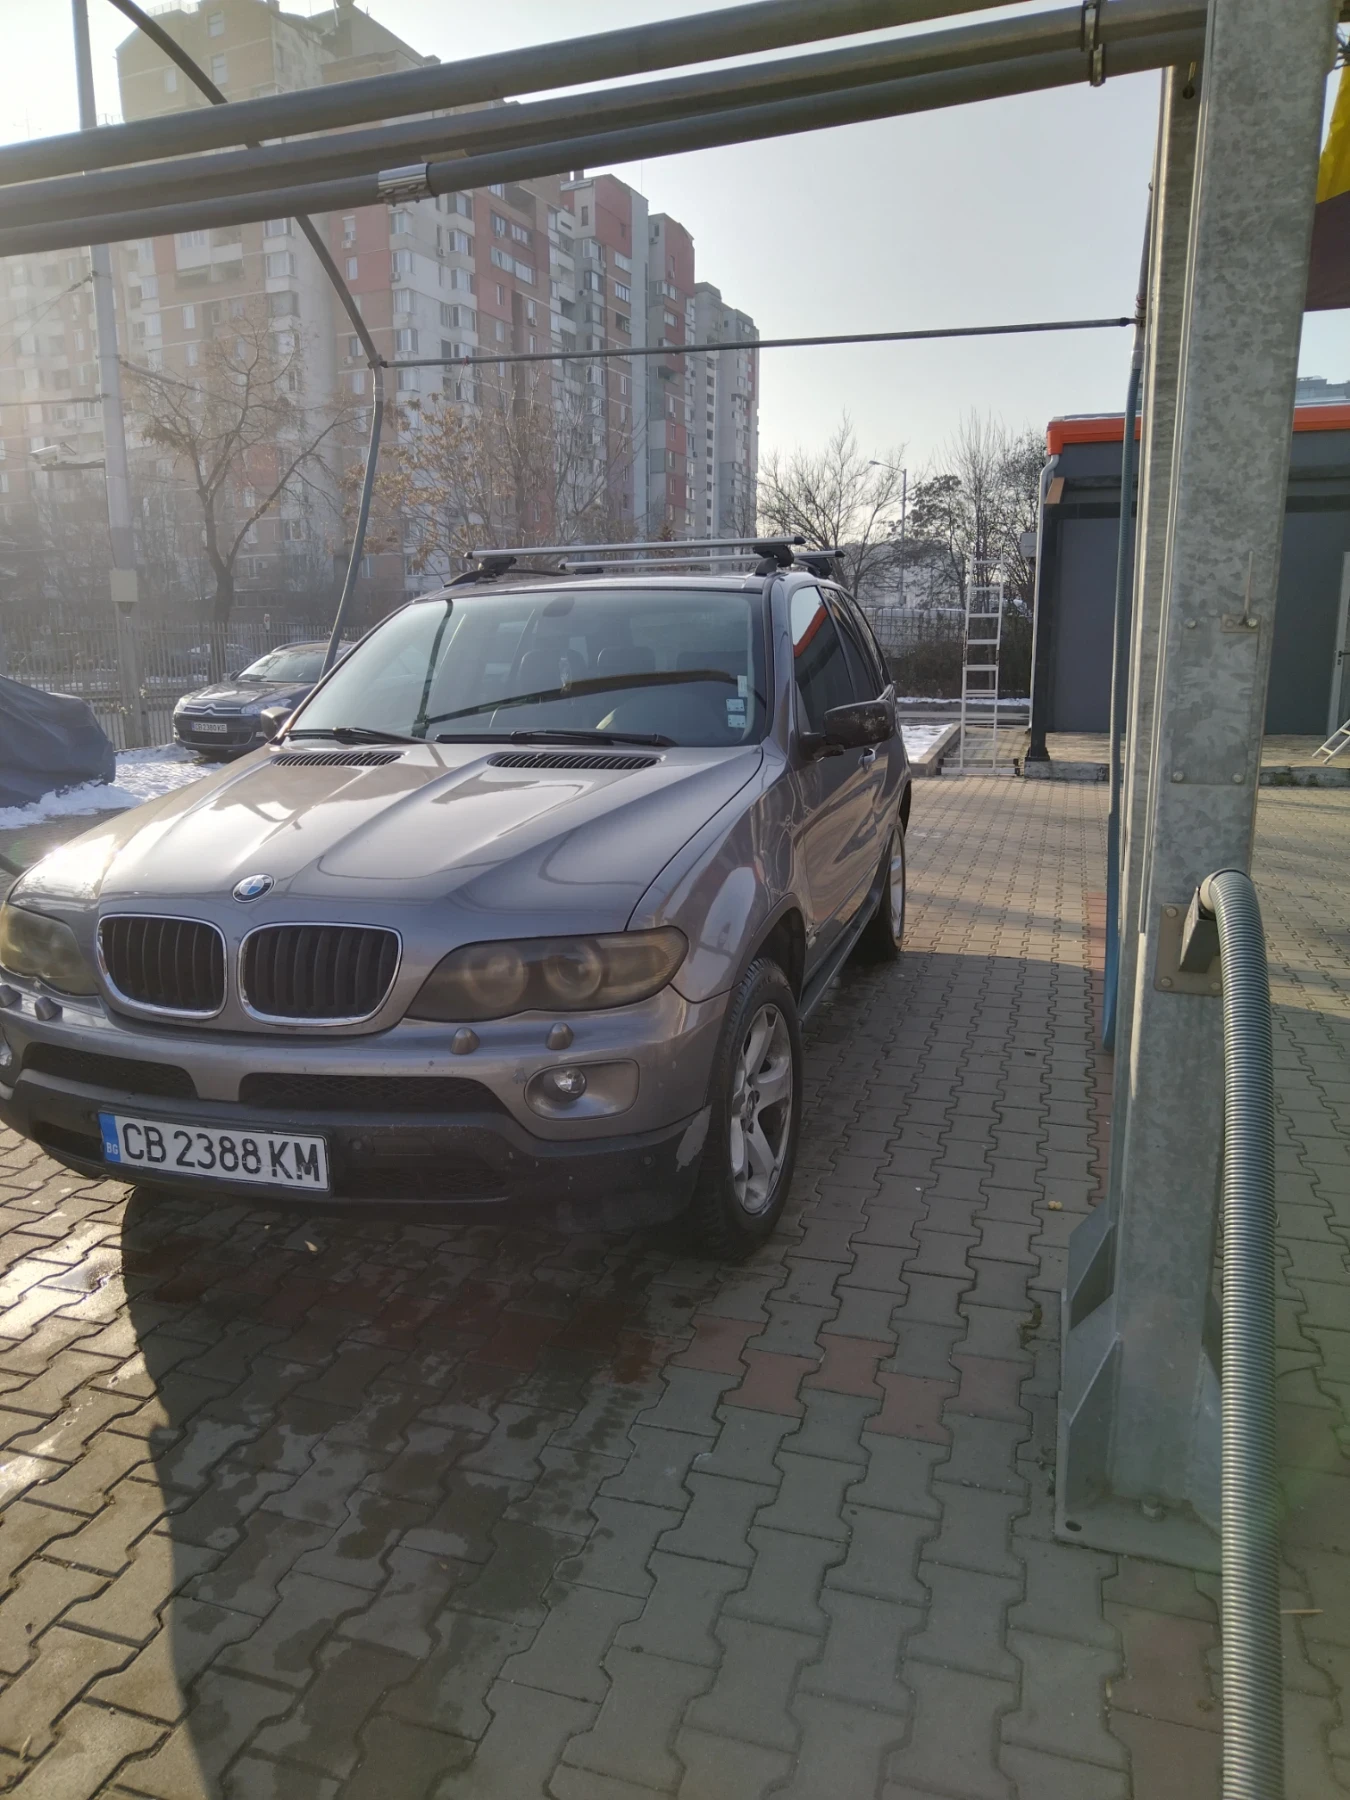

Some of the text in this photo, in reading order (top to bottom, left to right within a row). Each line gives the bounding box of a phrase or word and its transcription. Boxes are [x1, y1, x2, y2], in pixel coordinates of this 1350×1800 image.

[106, 1141, 119, 1155] BG
[122, 1122, 320, 1182] CB 2388 KM
